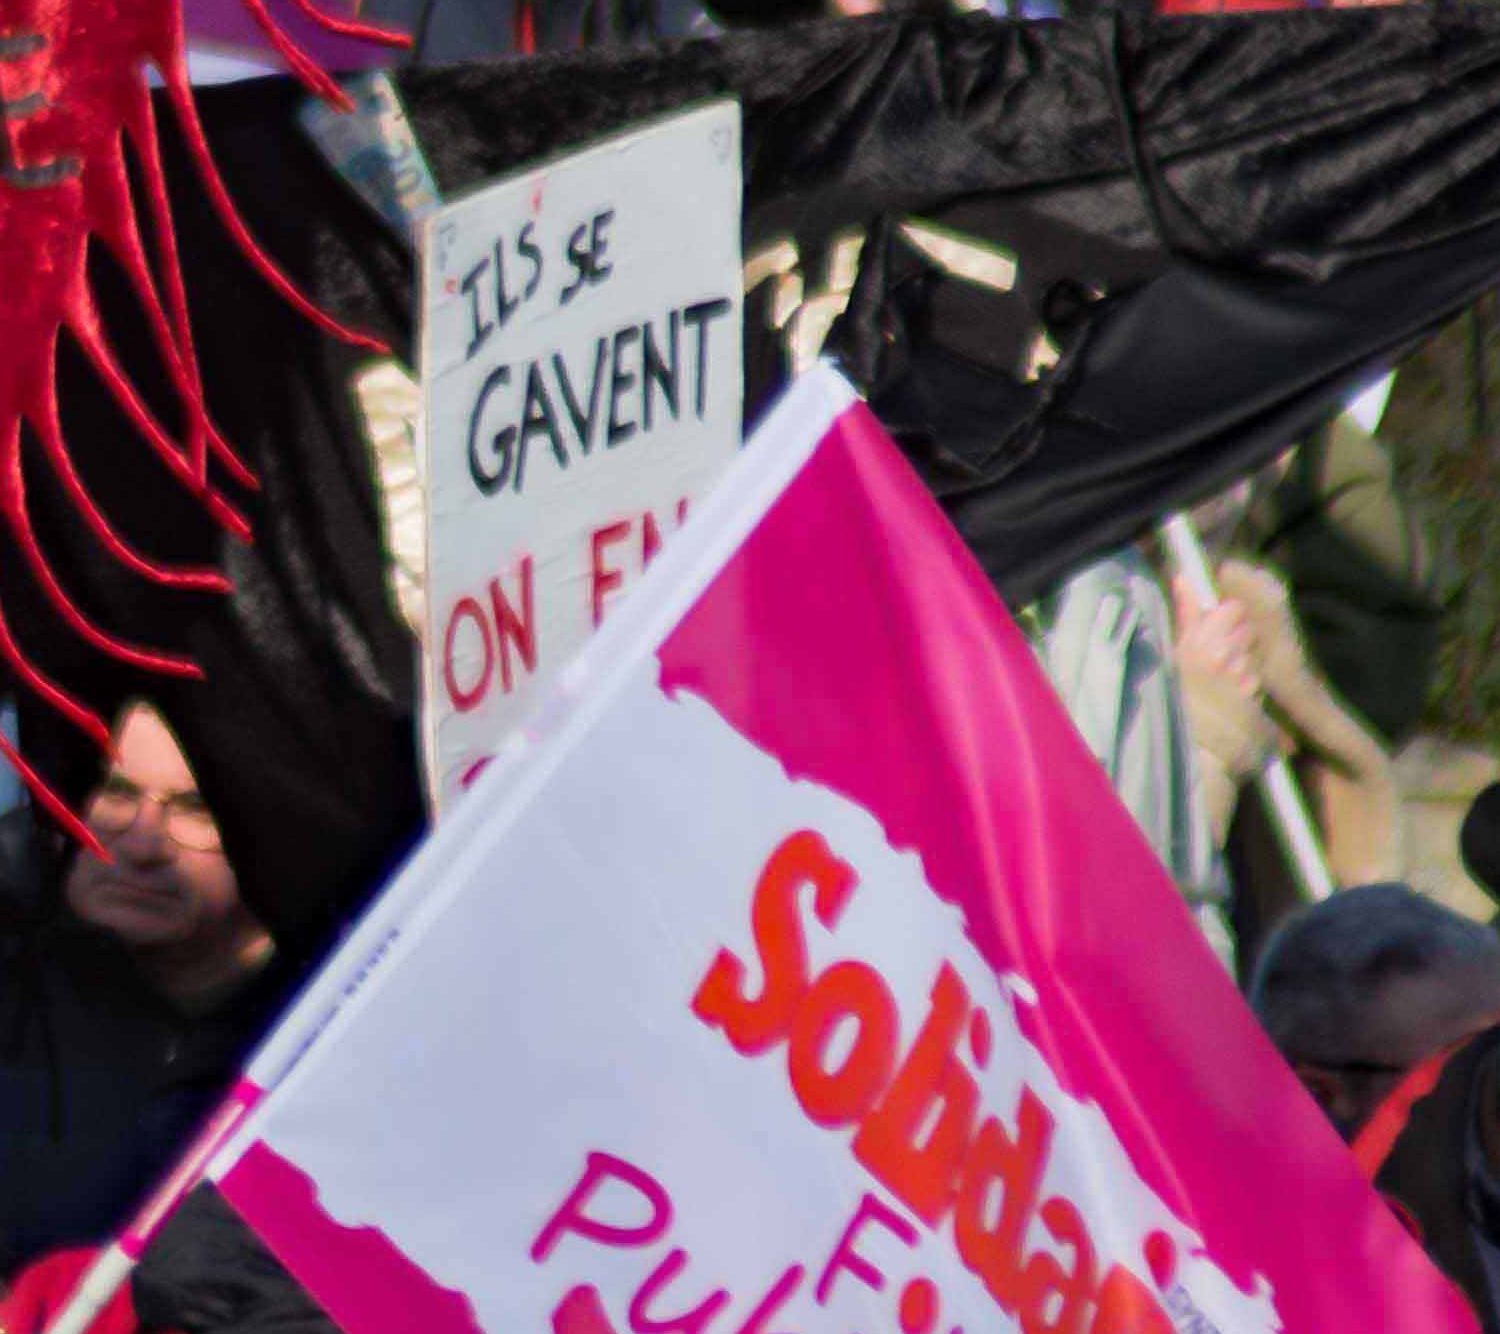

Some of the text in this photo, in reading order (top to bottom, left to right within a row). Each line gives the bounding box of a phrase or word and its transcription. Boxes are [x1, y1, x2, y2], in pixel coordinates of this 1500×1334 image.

[460, 209, 615, 361] ILS SE
[466, 297, 733, 498] GAVENT
[443, 553, 538, 714] ON
